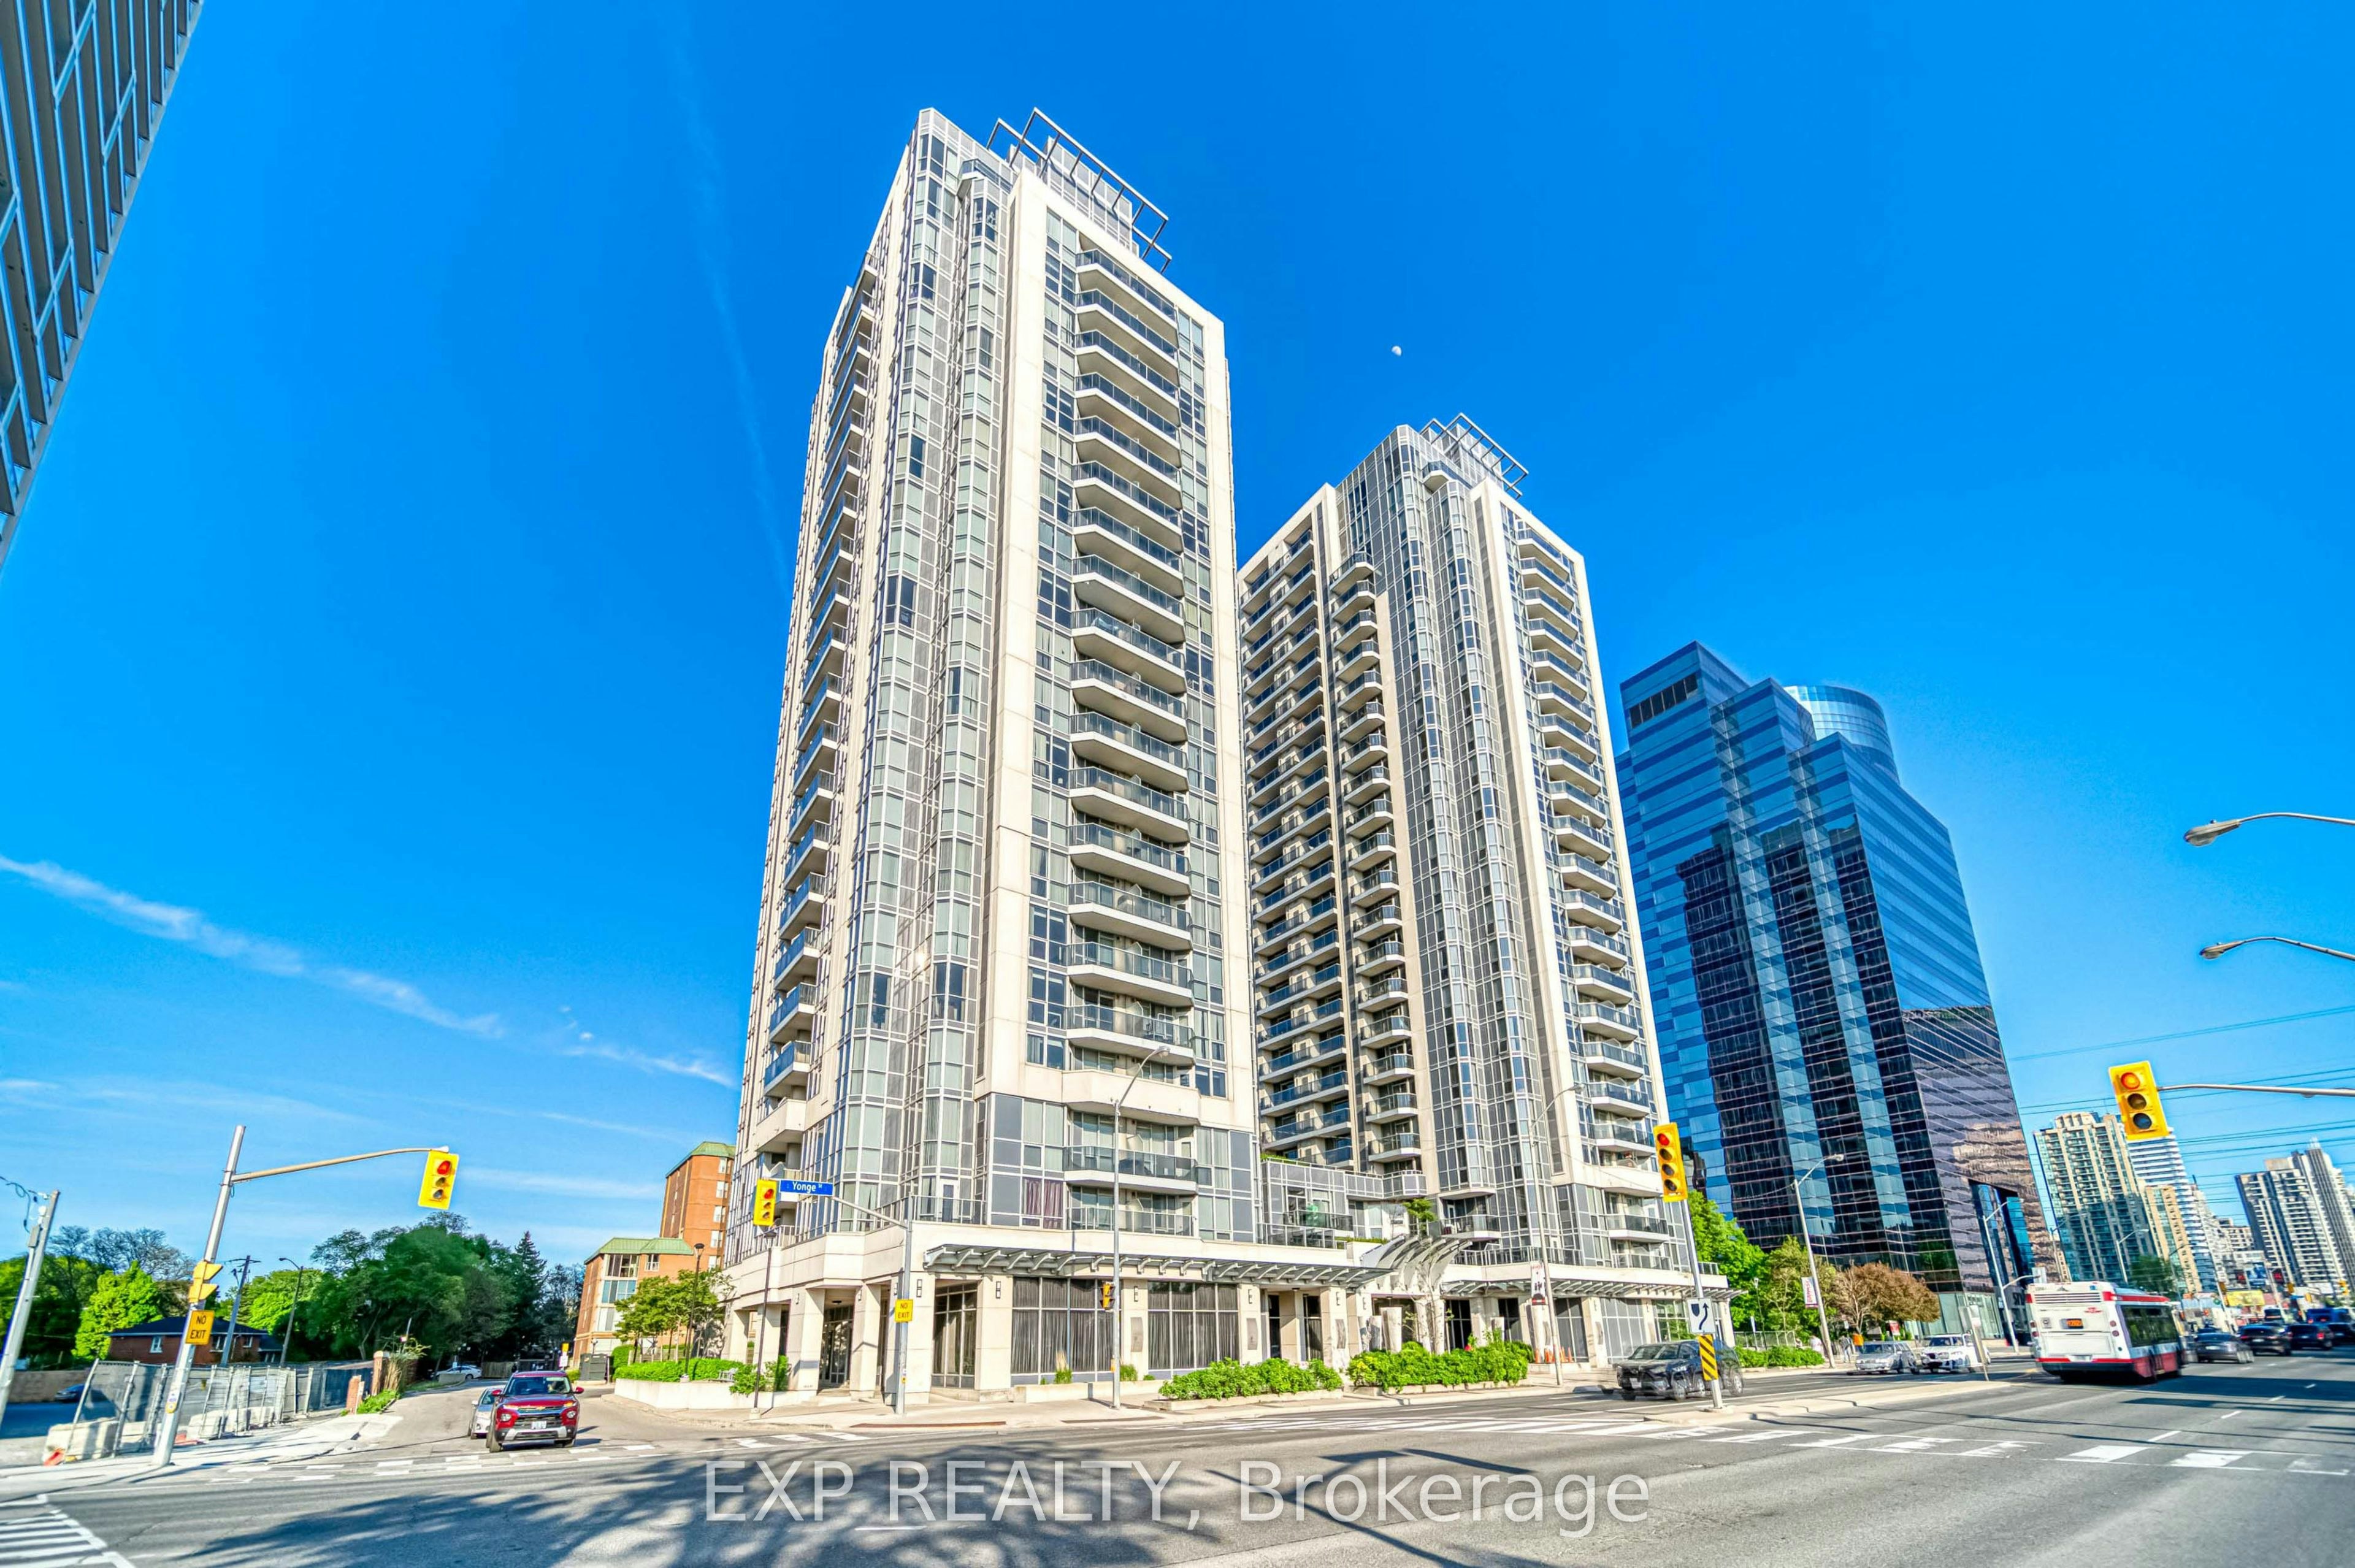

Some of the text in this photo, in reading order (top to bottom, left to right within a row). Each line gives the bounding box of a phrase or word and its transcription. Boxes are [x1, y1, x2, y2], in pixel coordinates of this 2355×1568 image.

[792, 1181, 816, 1193] Yonge
[196, 1315, 207, 1325] NO
[190, 1329, 207, 1339] EXIT
